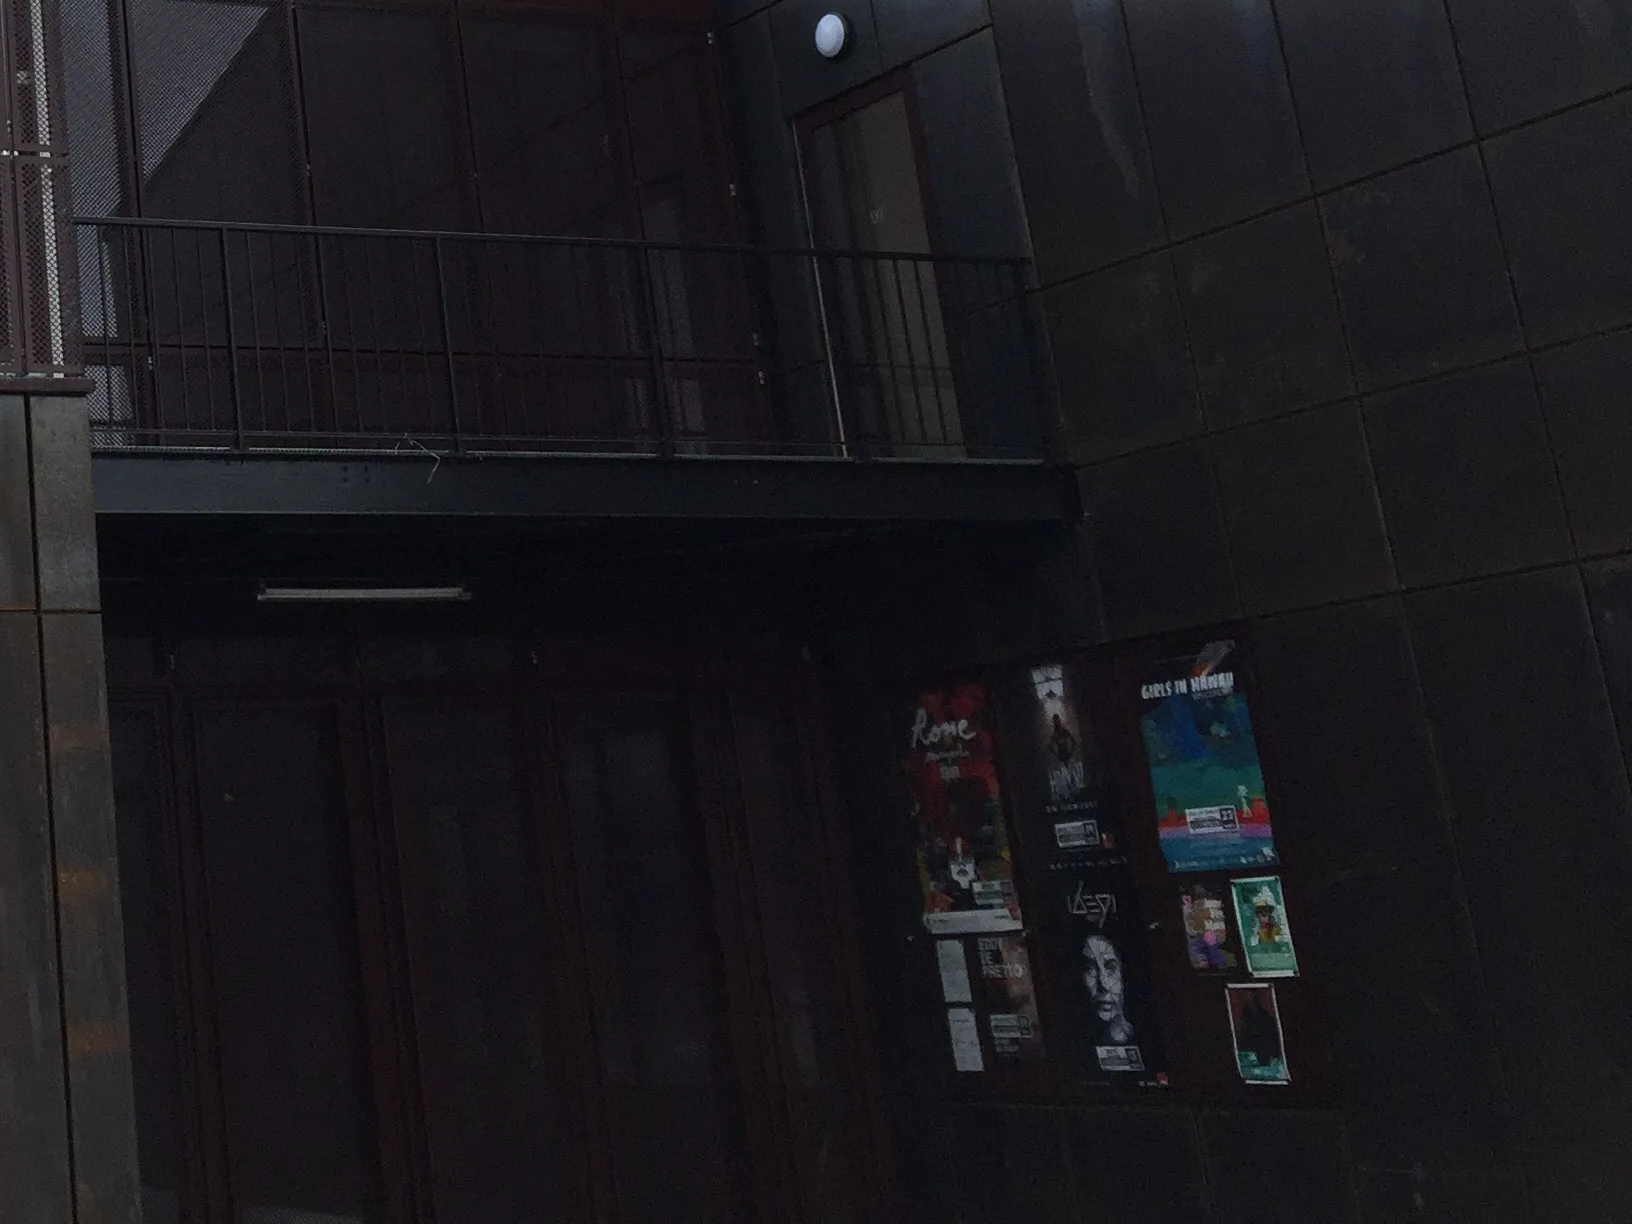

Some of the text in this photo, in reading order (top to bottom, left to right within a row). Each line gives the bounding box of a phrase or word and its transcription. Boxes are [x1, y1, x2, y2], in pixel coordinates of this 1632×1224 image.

[1141, 680, 1172, 700] GIRLS
[1174, 678, 1188, 695] IN
[1190, 671, 1234, 693] HAWAII
